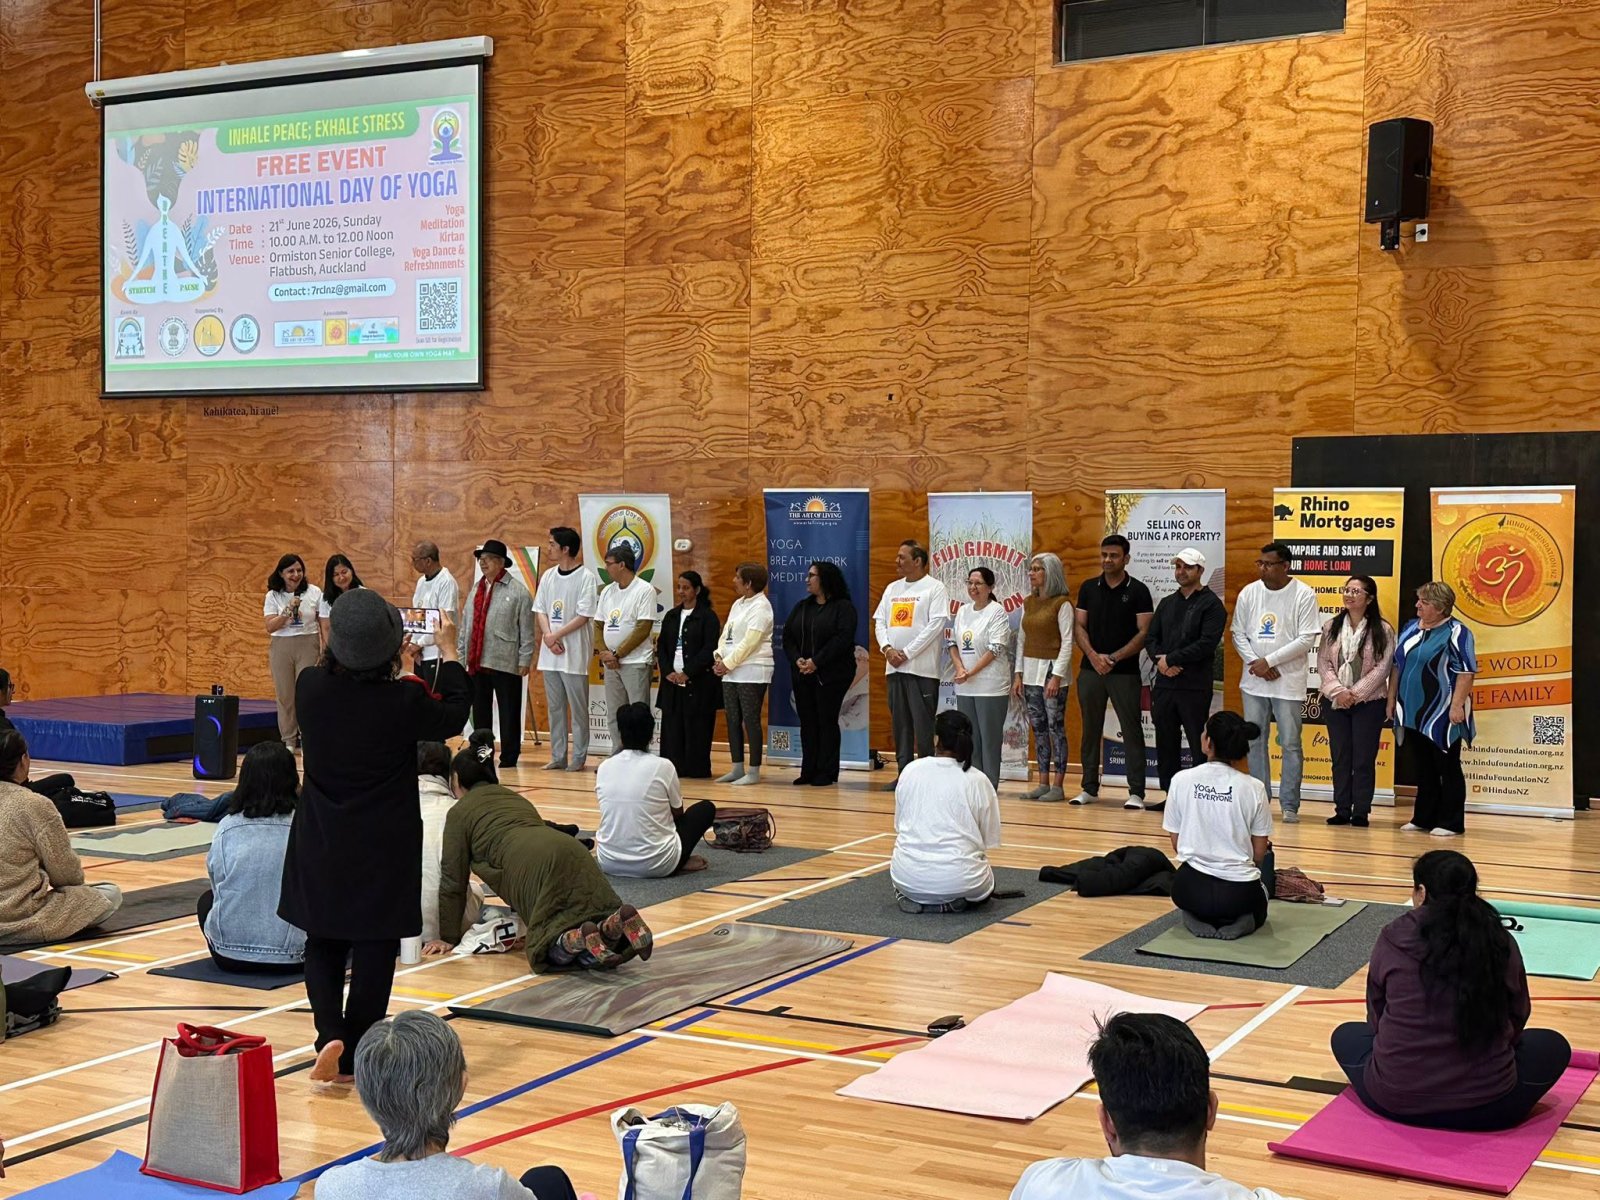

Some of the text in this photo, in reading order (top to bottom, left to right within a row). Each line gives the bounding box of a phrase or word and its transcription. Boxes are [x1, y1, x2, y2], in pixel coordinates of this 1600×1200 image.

[229, 111, 405, 146] INHALE PEACE; EXHALE STRESS
[256, 146, 387, 177] FREE EVENT
[197, 170, 458, 214] INTERNATIONAL DAY OF YOGA
[445, 204, 465, 217] Yoga
[229, 223, 252, 235] Date
[286, 219, 310, 231] June
[313, 217, 341, 229] 2026,
[343, 214, 382, 226] Sunday
[420, 217, 465, 230] Meditation
[230, 239, 254, 250] Time
[270, 235, 296, 248] 10.00
[299, 234, 321, 246] A.M.
[323, 233, 334, 243] to
[337, 231, 364, 243] 12.00
[366, 230, 394, 241] Noon
[440, 231, 465, 243] Kirtan
[269, 250, 317, 263] Ormiston
[319, 247, 352, 260] Senior
[354, 245, 395, 259] College,
[412, 247, 430, 259] Yoga
[432, 245, 457, 257] Dance
[269, 261, 366, 277] Flatbush, Auckland
[203, 406, 249, 417] Kahikatea,
[249, 405, 259, 415] hi
[1301, 496, 1350, 511] Rhino
[1147, 519, 1202, 530] SELLING OR
[1300, 513, 1396, 532] Mortgages
[1127, 531, 1221, 541] BUYING A PROPERTY?
[769, 538, 803, 550] YOGA
[1322, 545, 1340, 556] AND
[1341, 545, 1362, 556] SAVE
[1364, 545, 1376, 556] ON
[1506, 519, 1530, 531] HINDU
[1529, 529, 1557, 570] FOUNDATION
[932, 543, 961, 568] FIJI
[964, 541, 1027, 568] GIRMIT
[1303, 560, 1328, 571] HOME
[1330, 560, 1351, 571] LOAN
[770, 572, 805, 582] MEDIT
[1314, 586, 1337, 594] HOME
[1489, 654, 1558, 671] WORLD
[1491, 685, 1555, 703] FAMILY
[1193, 783, 1217, 795] YOGA
[1482, 786, 1530, 796] @HindusNZ
[1197, 792, 1233, 803] EVERYONE
